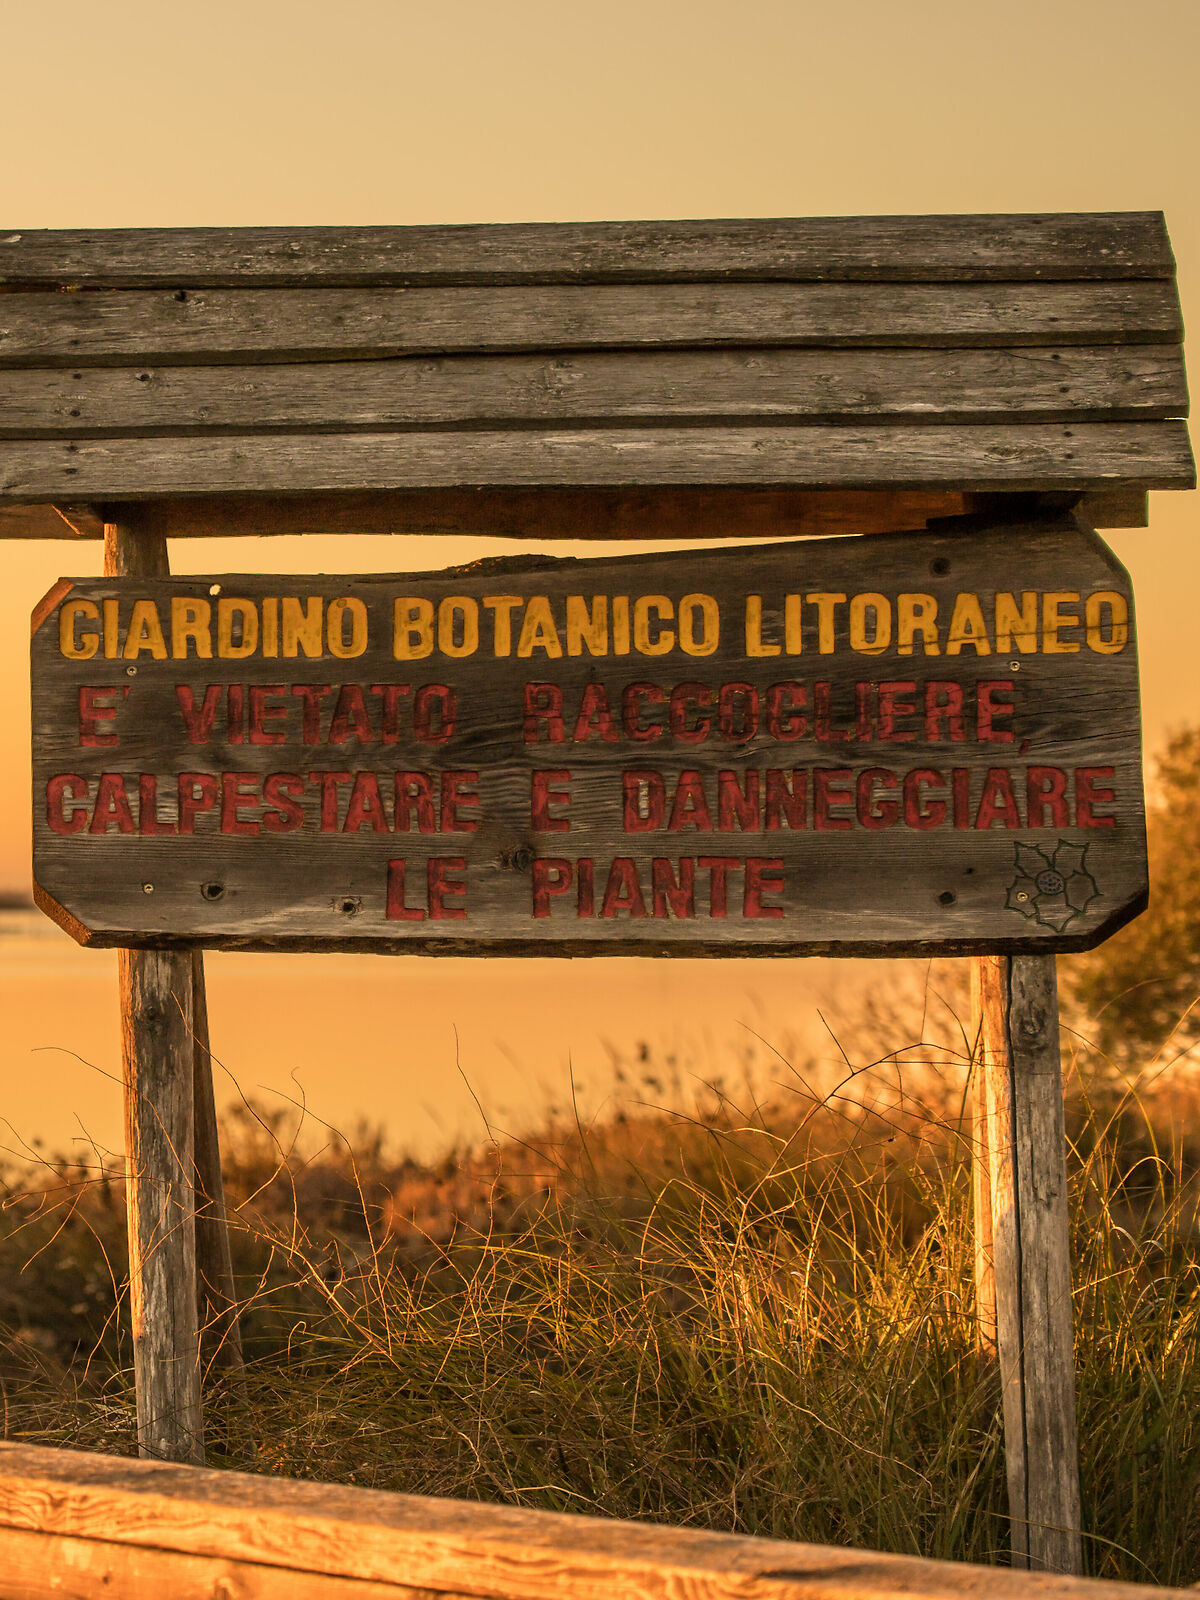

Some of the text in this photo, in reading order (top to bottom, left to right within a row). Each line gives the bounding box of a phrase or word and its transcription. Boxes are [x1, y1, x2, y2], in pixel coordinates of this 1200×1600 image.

[59, 591, 1129, 660] GIARDINO BOTANICO LITORANEO
[79, 685, 130, 747] E'
[175, 683, 458, 745] VIETATO
[46, 766, 1116, 835] CALPESTARE E DANNEGGIARE
[386, 856, 785, 921] LE PIANTE
